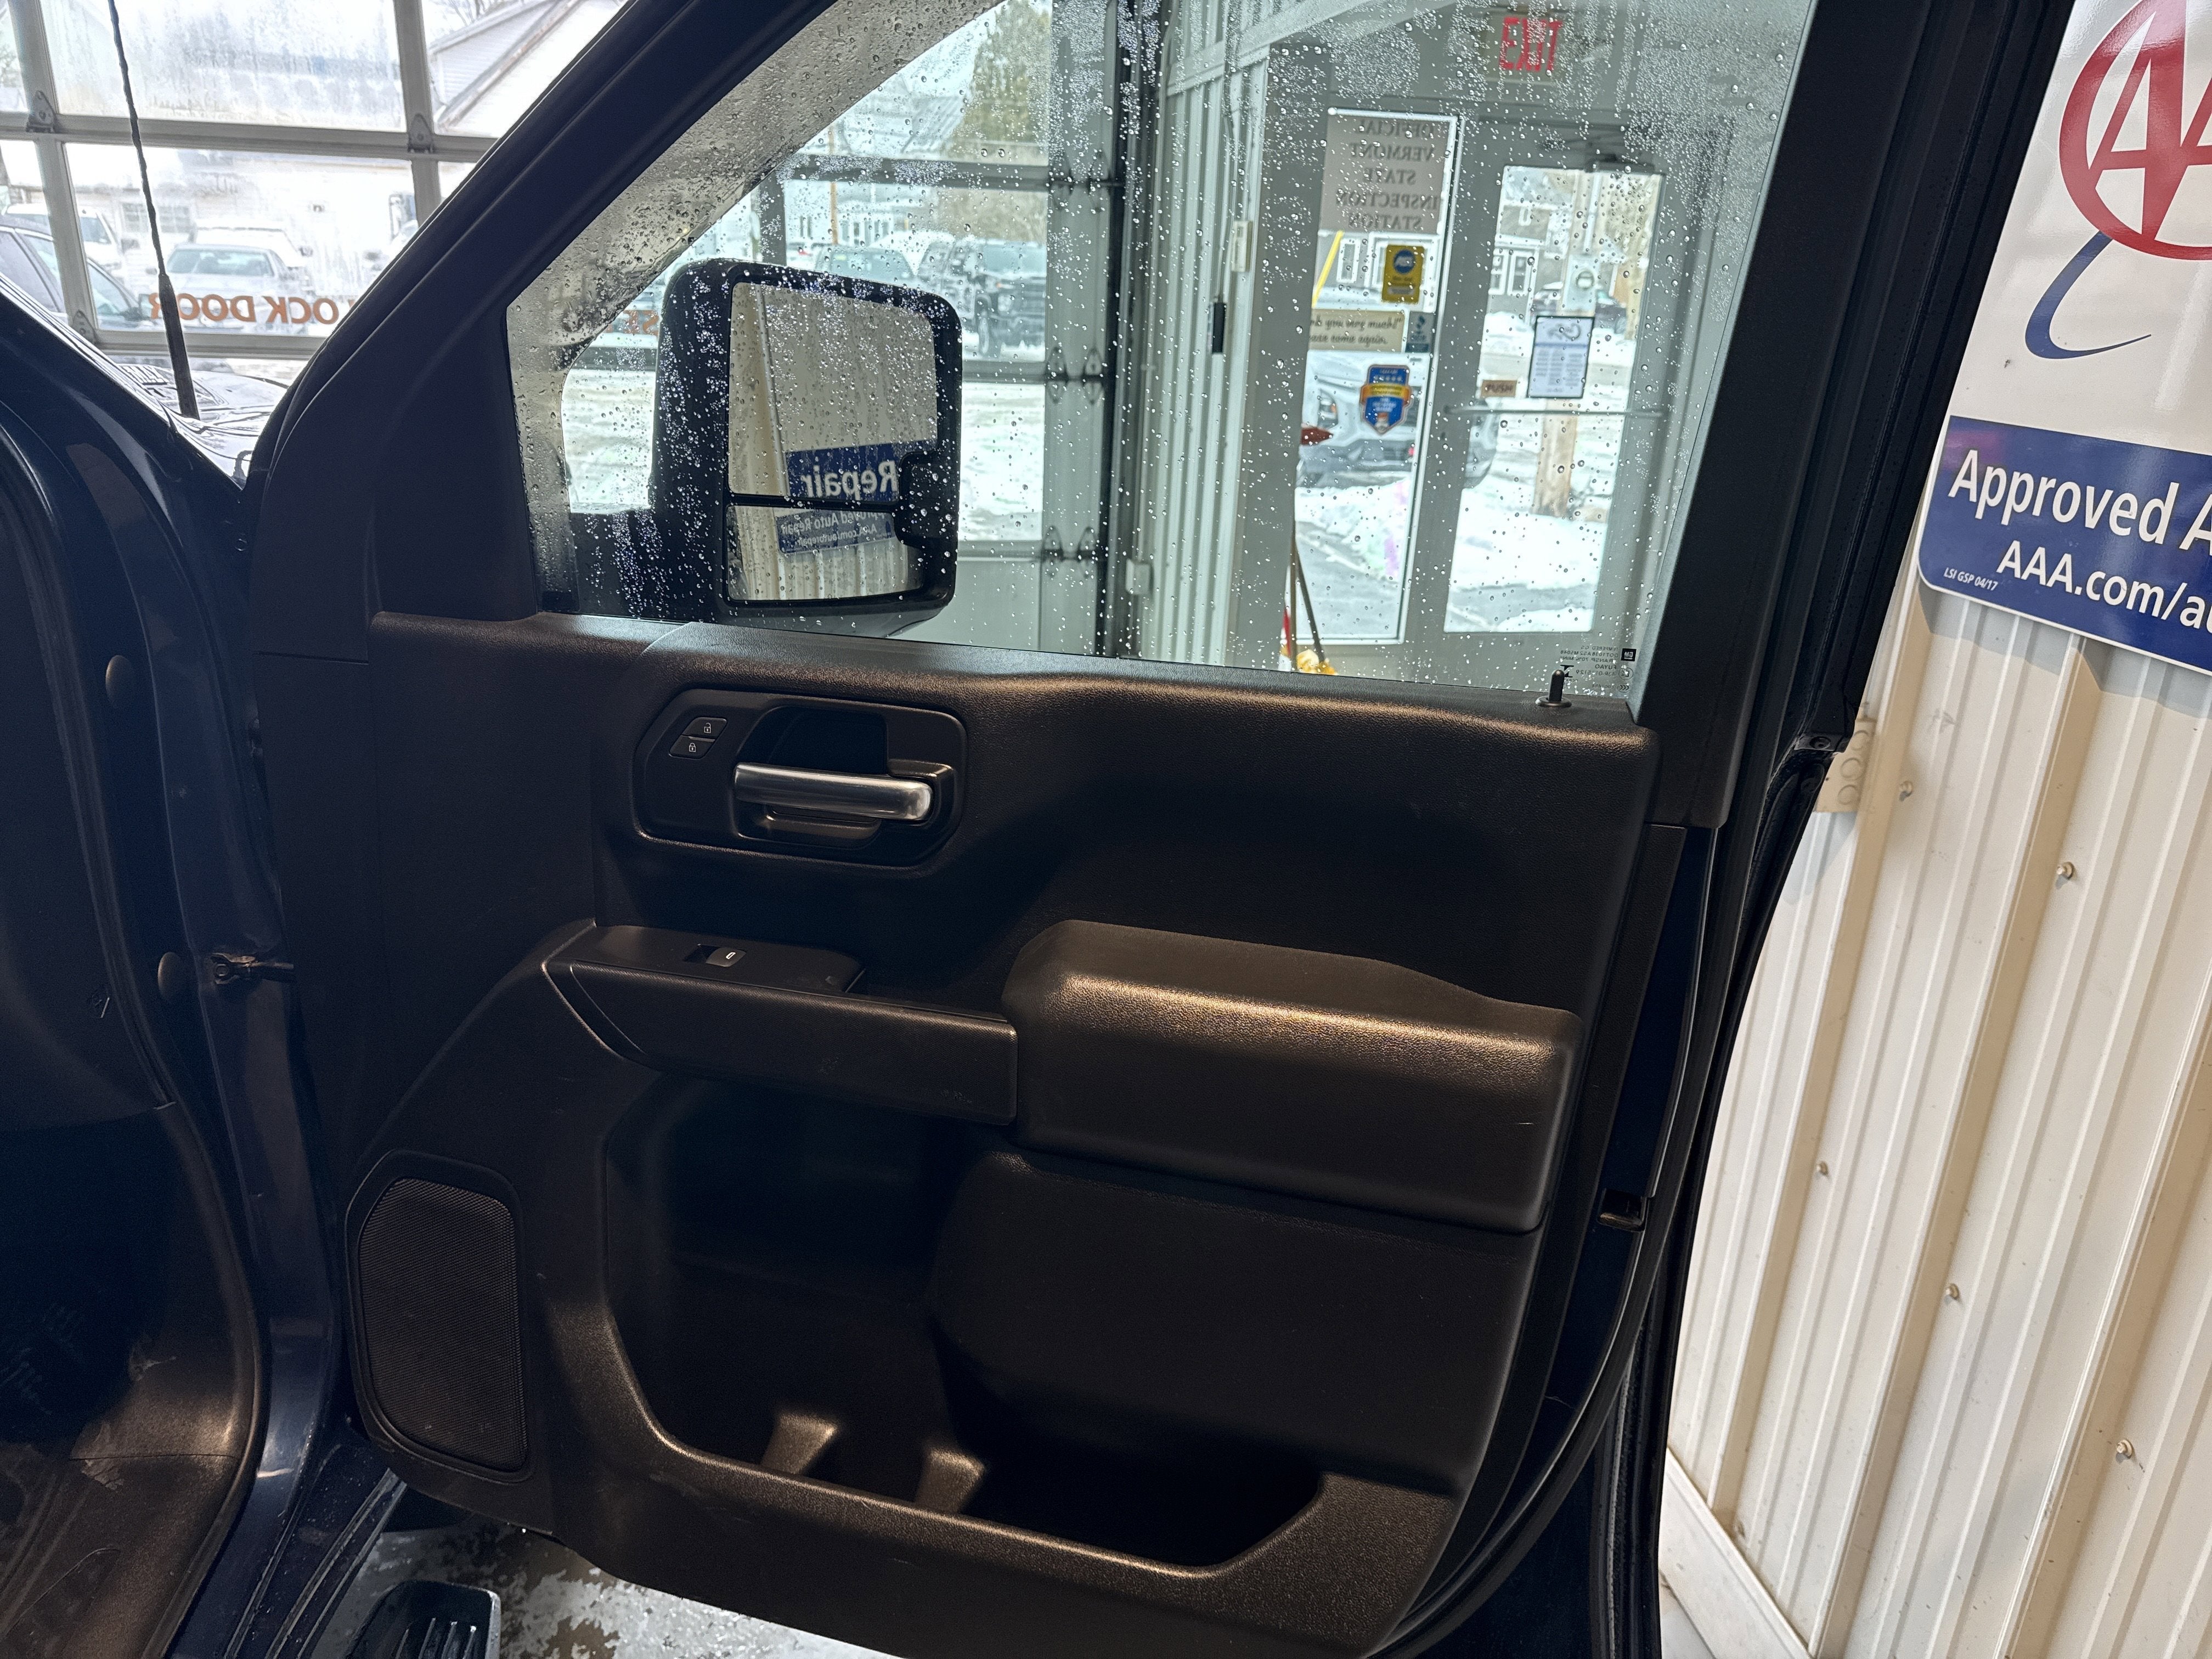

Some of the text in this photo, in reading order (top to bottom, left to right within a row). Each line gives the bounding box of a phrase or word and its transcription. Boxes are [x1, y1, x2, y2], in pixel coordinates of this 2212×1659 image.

[1499, 16, 1562, 71] EXIT
[1948, 449, 2179, 545] Approved
[1944, 567, 1999, 591] LSI GSP 04/17
